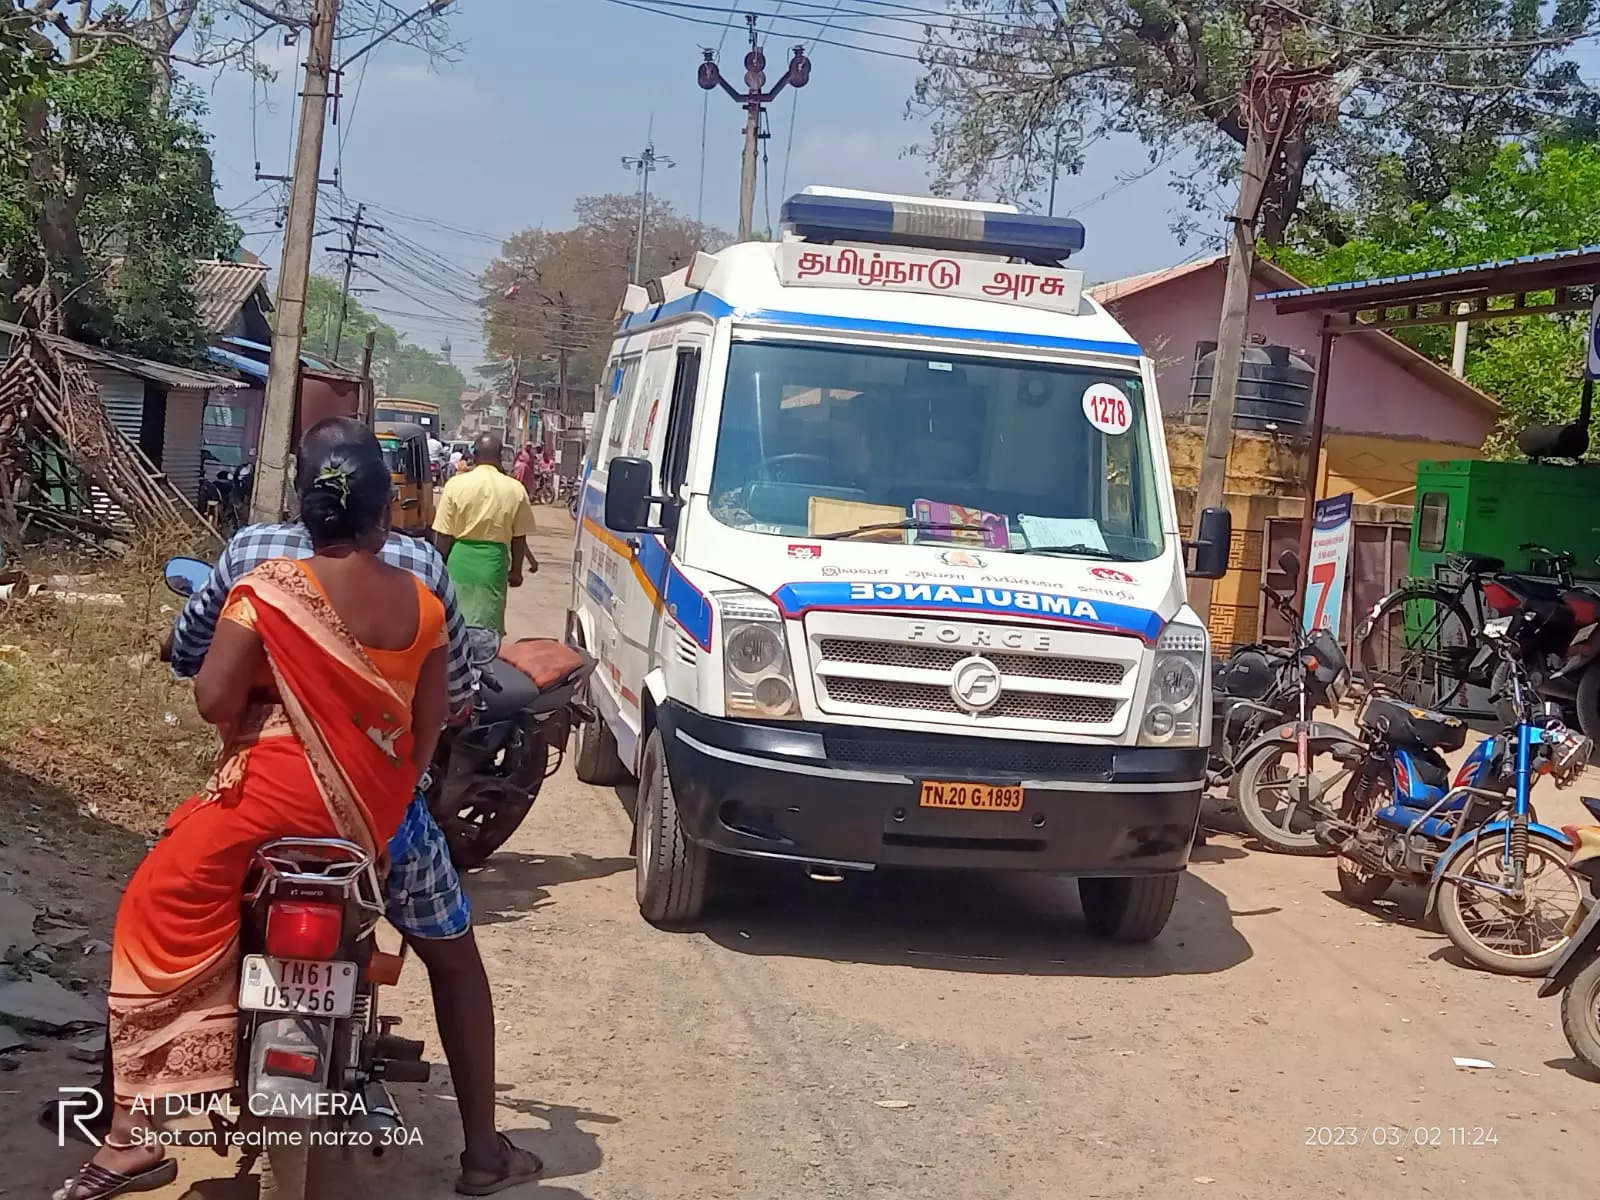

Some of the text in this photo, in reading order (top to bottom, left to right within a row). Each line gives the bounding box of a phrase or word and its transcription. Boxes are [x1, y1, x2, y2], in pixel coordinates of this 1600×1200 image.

[797, 249, 1065, 299] தமிழ்நாடு அரசு
[1091, 395, 1126, 427] 1278
[908, 623, 1051, 652] FORCE
[924, 786, 1020, 807] TN.20 G.1893
[280, 961, 333, 987] TN61
[264, 985, 335, 1012] U5756
